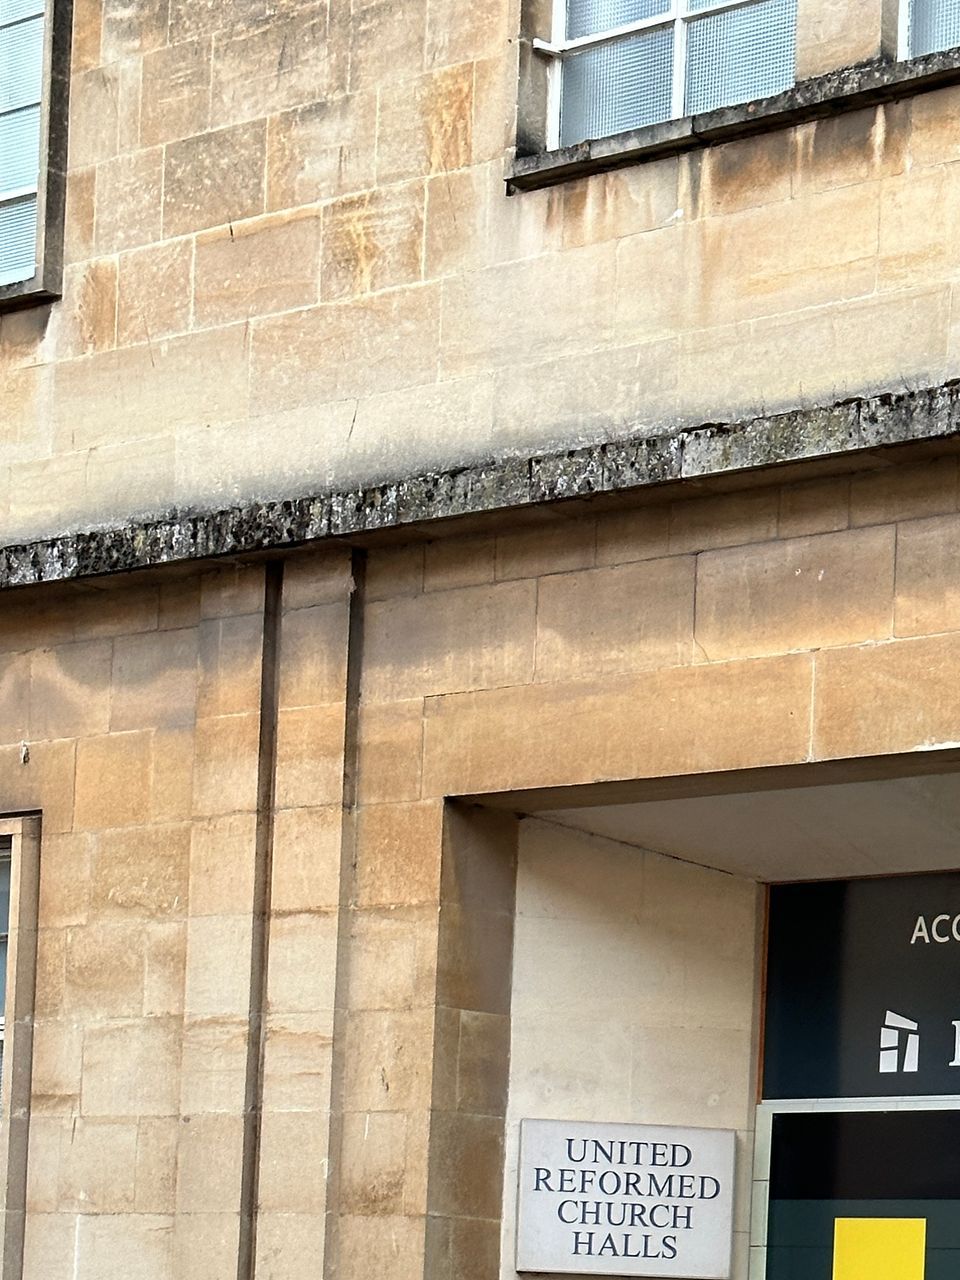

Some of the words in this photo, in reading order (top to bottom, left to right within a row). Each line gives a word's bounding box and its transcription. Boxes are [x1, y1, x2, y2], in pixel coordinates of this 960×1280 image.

[565, 1138, 693, 1168] UNITED
[532, 1167, 721, 1200] REFORMED
[557, 1199, 694, 1229] CHURCH
[571, 1231, 678, 1260] HALLS
